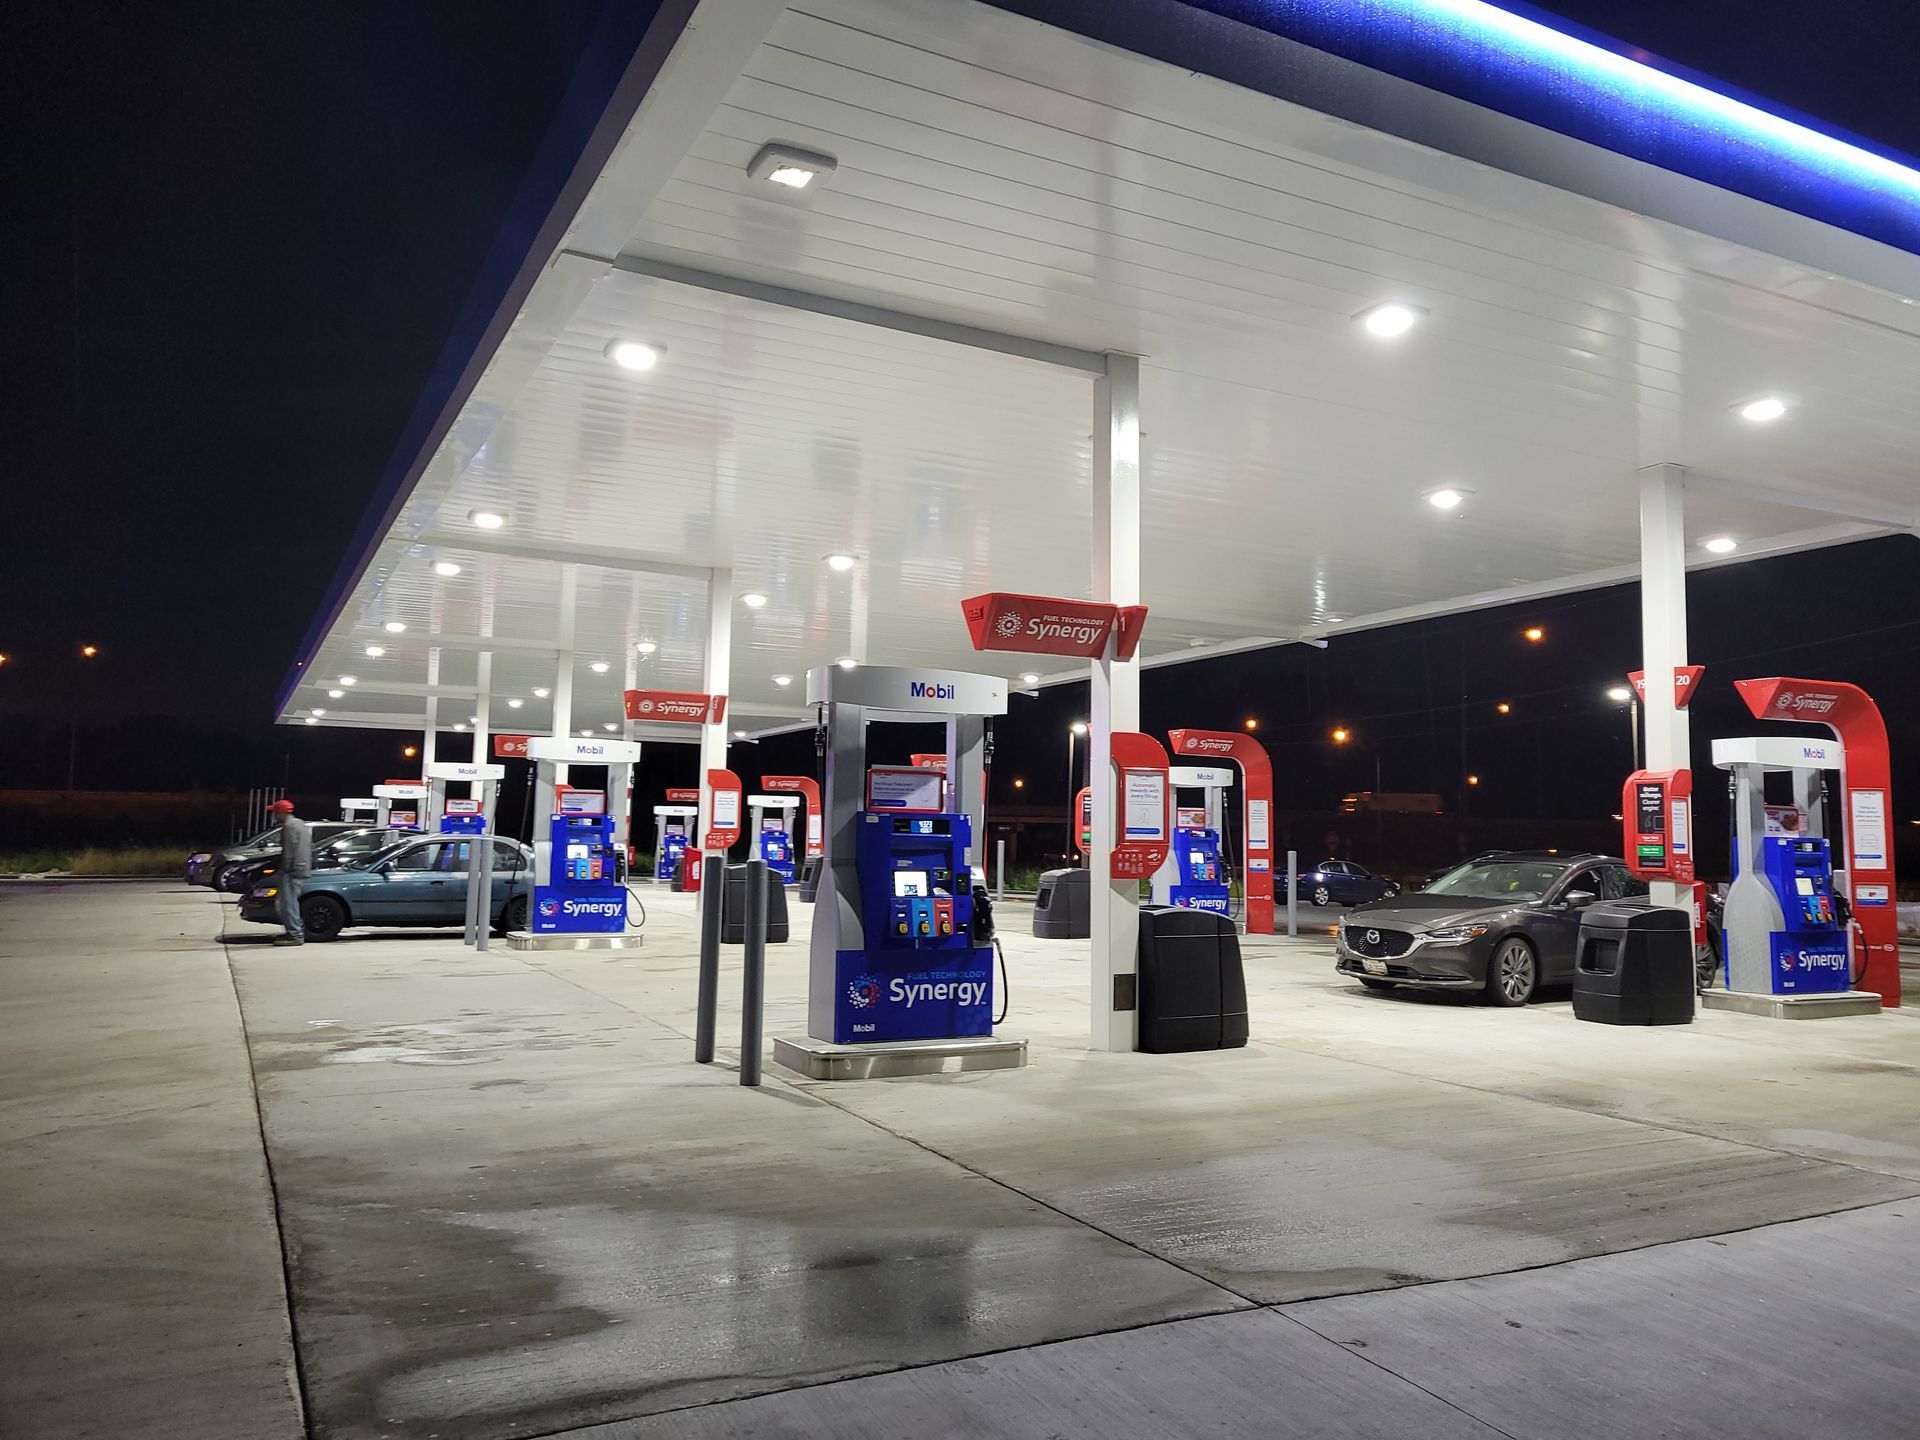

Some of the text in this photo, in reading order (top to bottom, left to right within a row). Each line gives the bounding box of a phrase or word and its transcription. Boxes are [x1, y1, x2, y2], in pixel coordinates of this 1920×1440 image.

[1043, 614, 1105, 626] FUEL TECHNOLOGY
[1026, 618, 1102, 644] Synergy
[1675, 674, 1691, 686] 20
[911, 682, 955, 700] Mobil
[657, 702, 704, 717] Synergy
[1792, 695, 1836, 713] Synergy
[577, 745, 604, 755] Mobil
[1199, 740, 1233, 752] Synergy
[1196, 773, 1214, 781] Mobil
[563, 900, 623, 917] Synergy
[1189, 897, 1227, 909] Synergy
[1798, 951, 1846, 972] Synergy
[907, 971, 987, 980] FUEL TECHNOLOGY
[889, 978, 987, 1009] Synergy
[853, 1023, 875, 1033] Mobil
